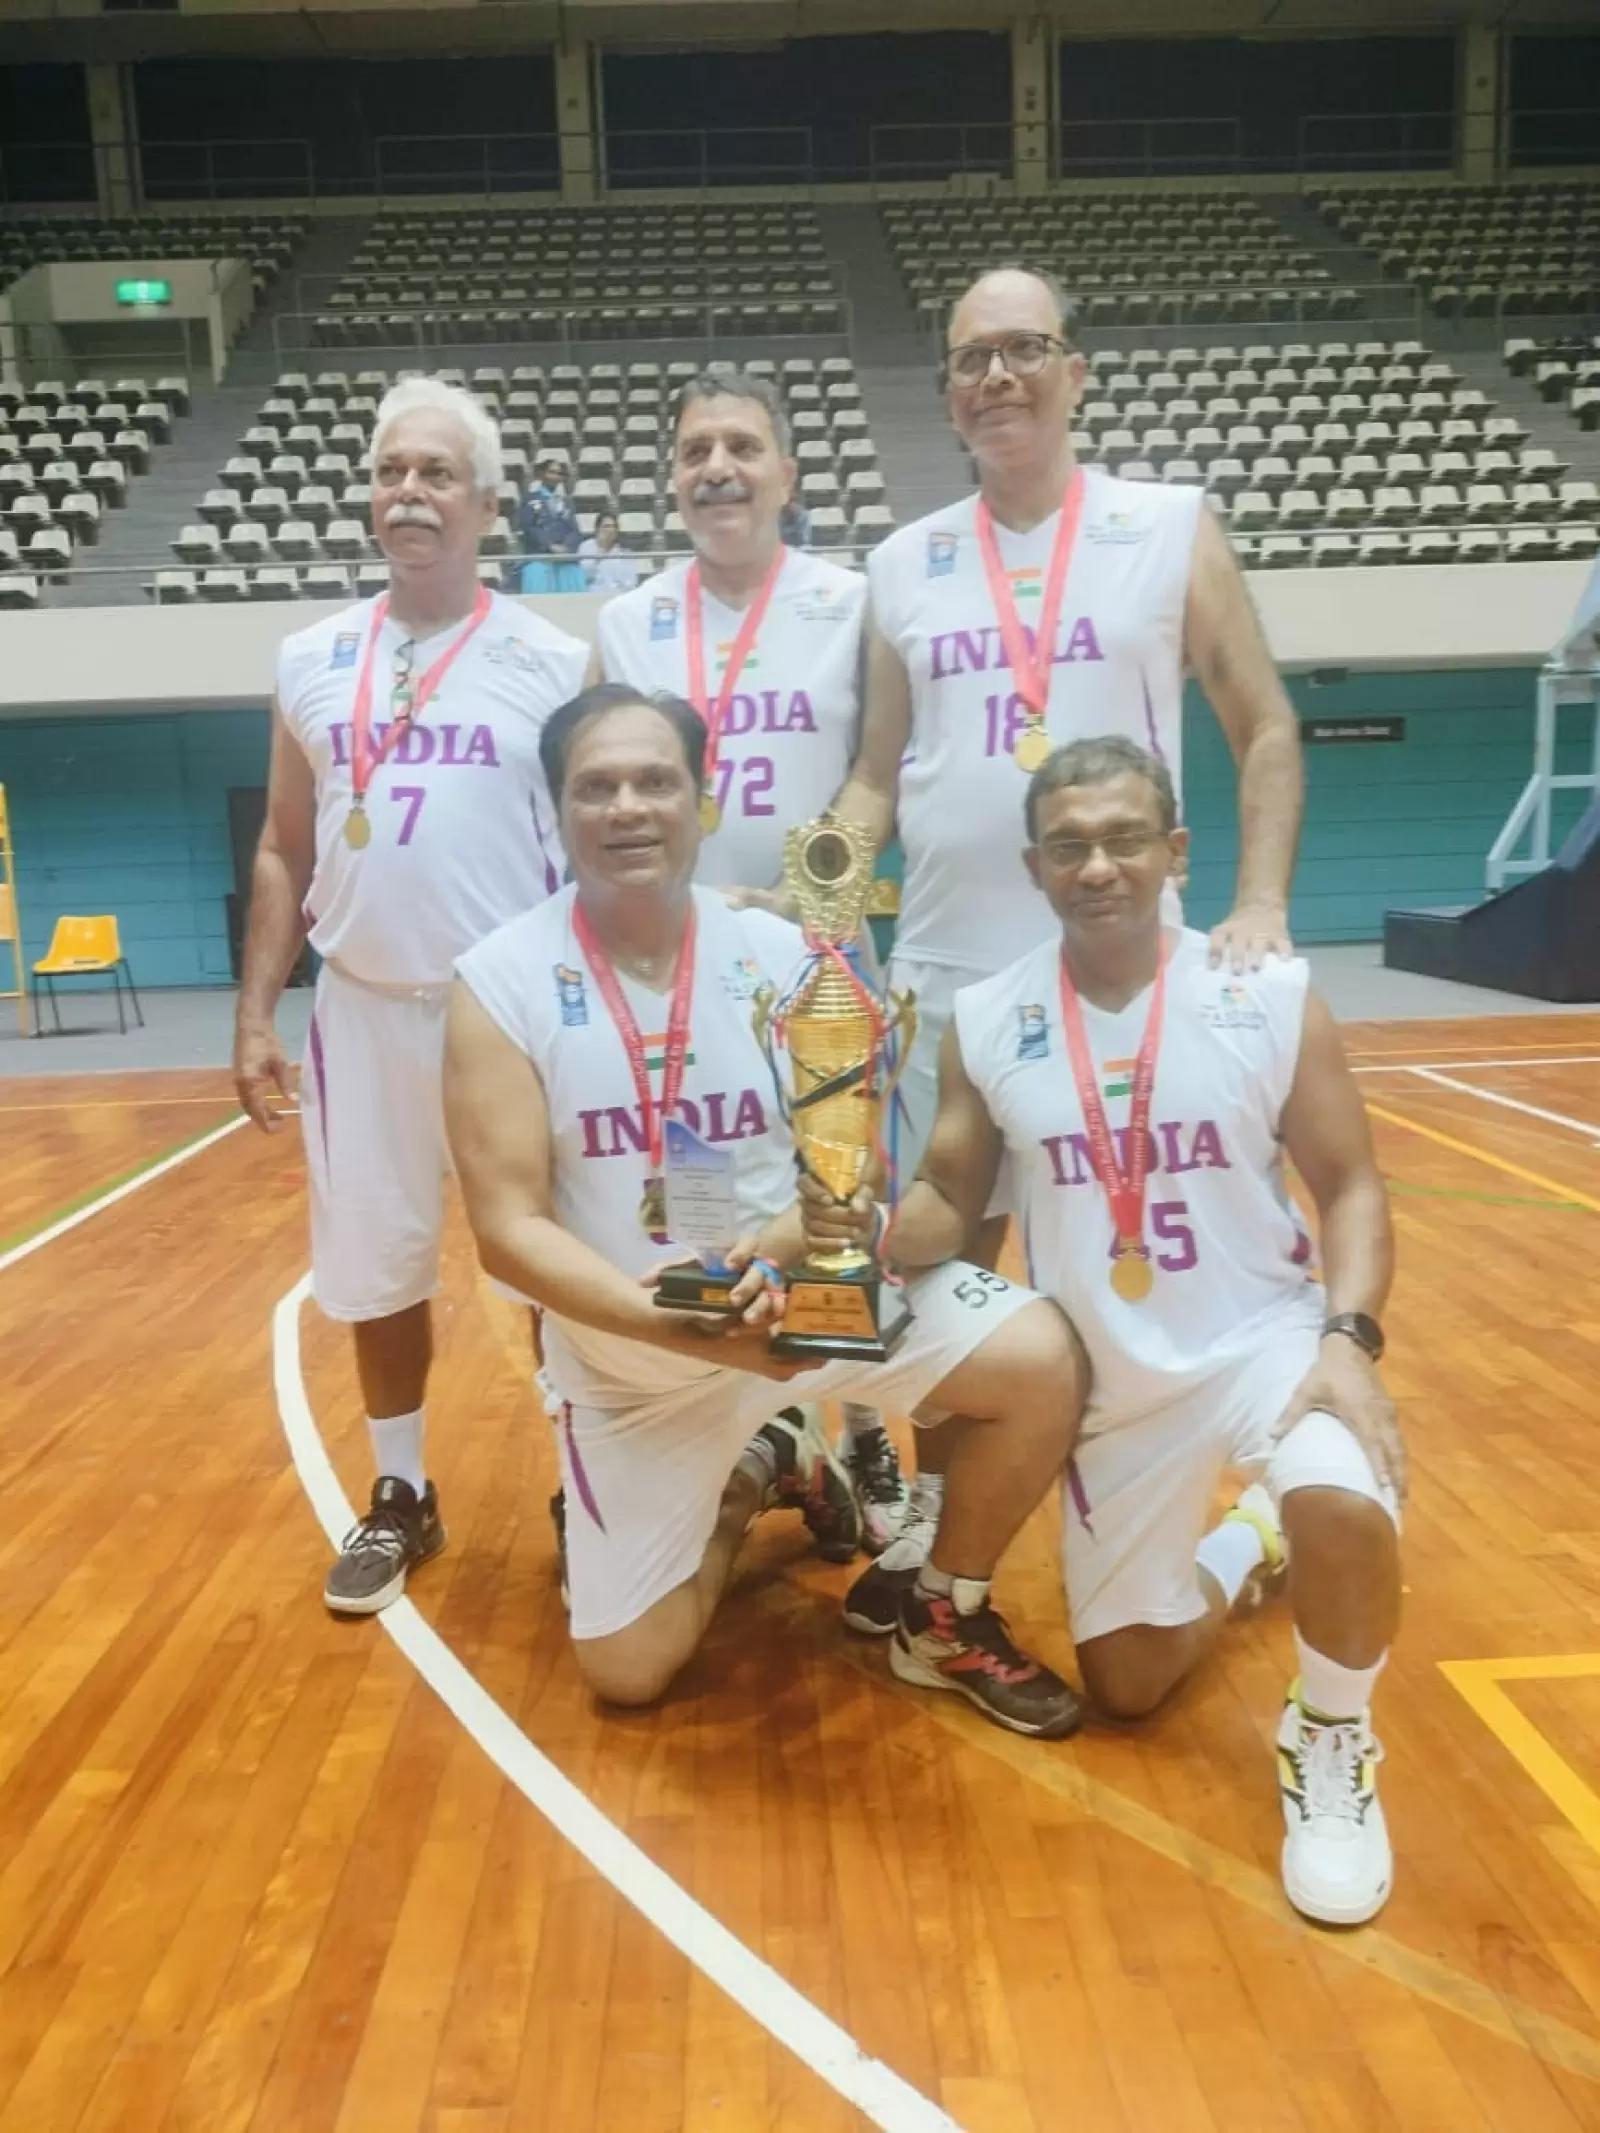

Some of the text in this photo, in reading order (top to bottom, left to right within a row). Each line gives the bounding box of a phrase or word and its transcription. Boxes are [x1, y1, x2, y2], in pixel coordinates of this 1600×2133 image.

[716, 755, 775, 817] 72
[390, 787, 426, 846] 7
[1108, 1200, 1199, 1272] 5
[952, 1270, 1010, 1309] 55
